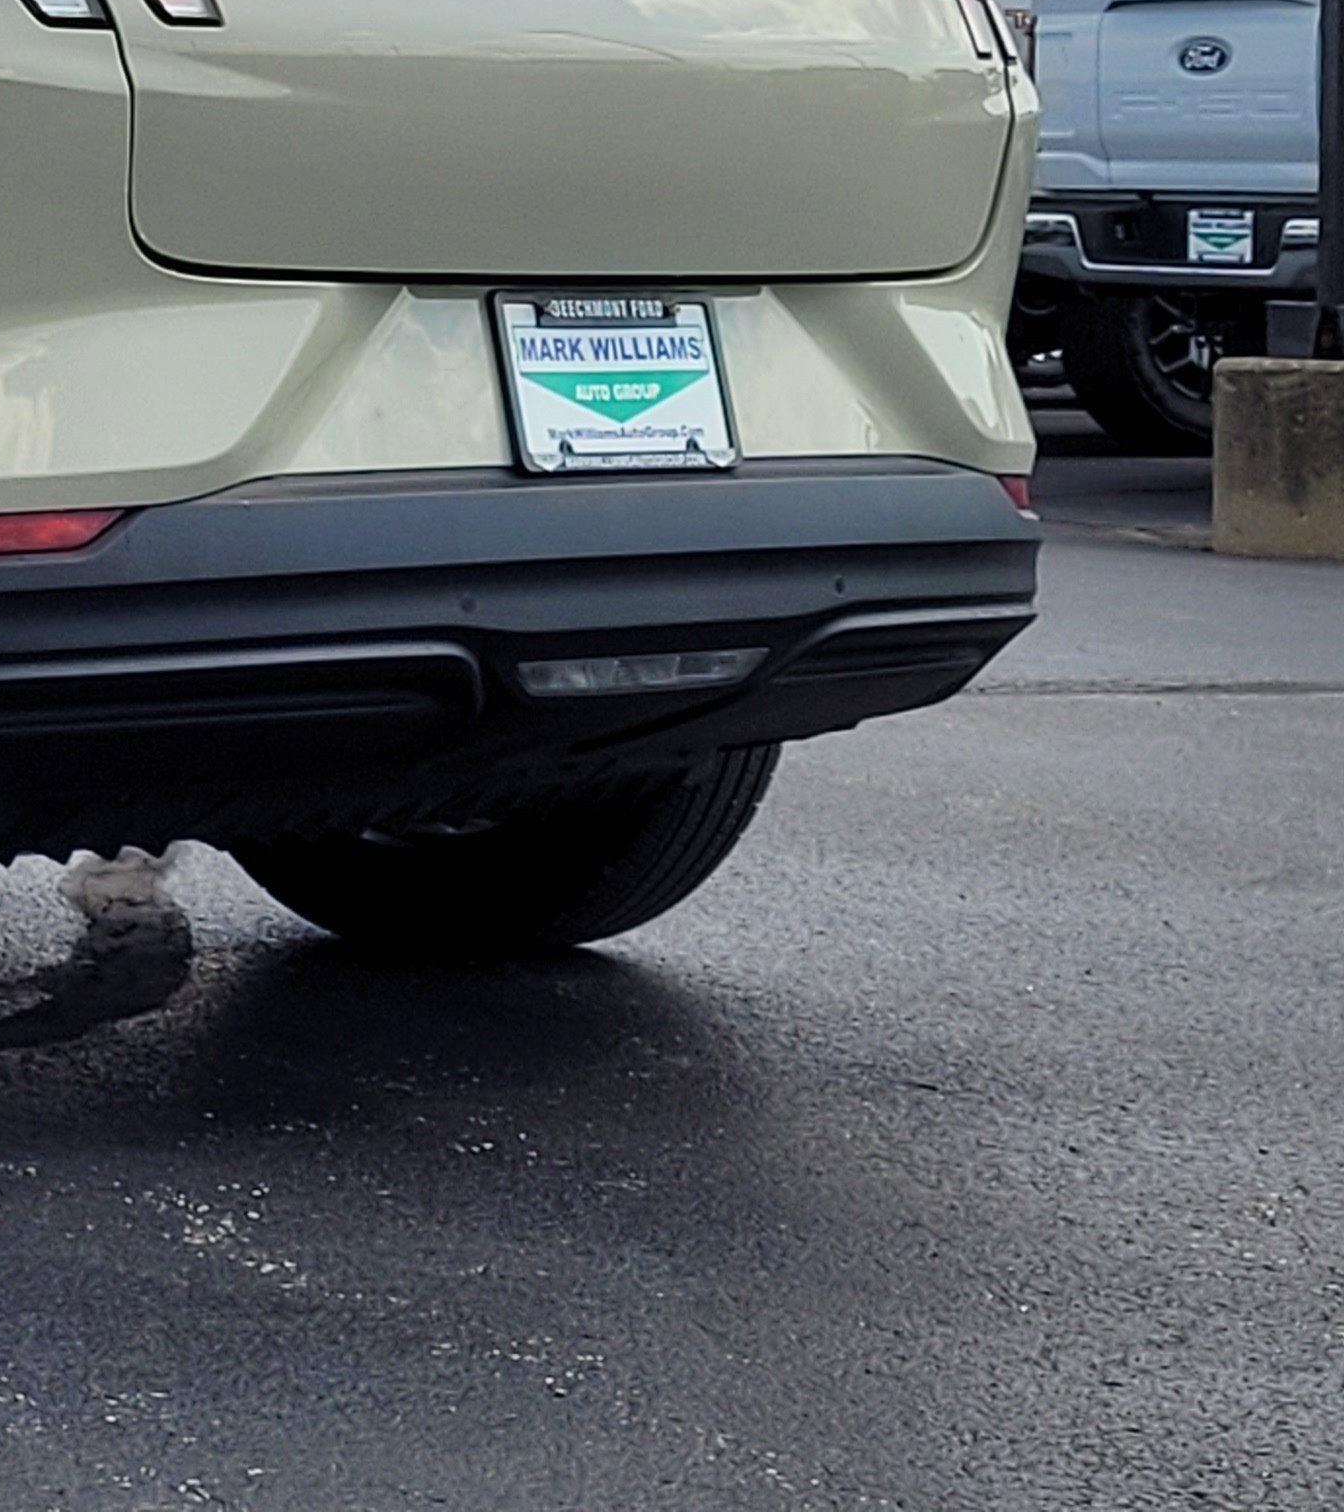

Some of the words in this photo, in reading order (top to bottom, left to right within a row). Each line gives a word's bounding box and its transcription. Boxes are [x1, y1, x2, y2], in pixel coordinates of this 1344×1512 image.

[631, 299, 664, 318] FORD
[519, 338, 585, 362] MARK
[589, 337, 702, 362] WILLIAMS
[575, 384, 611, 401] AUTO
[613, 383, 661, 401] GROUP
